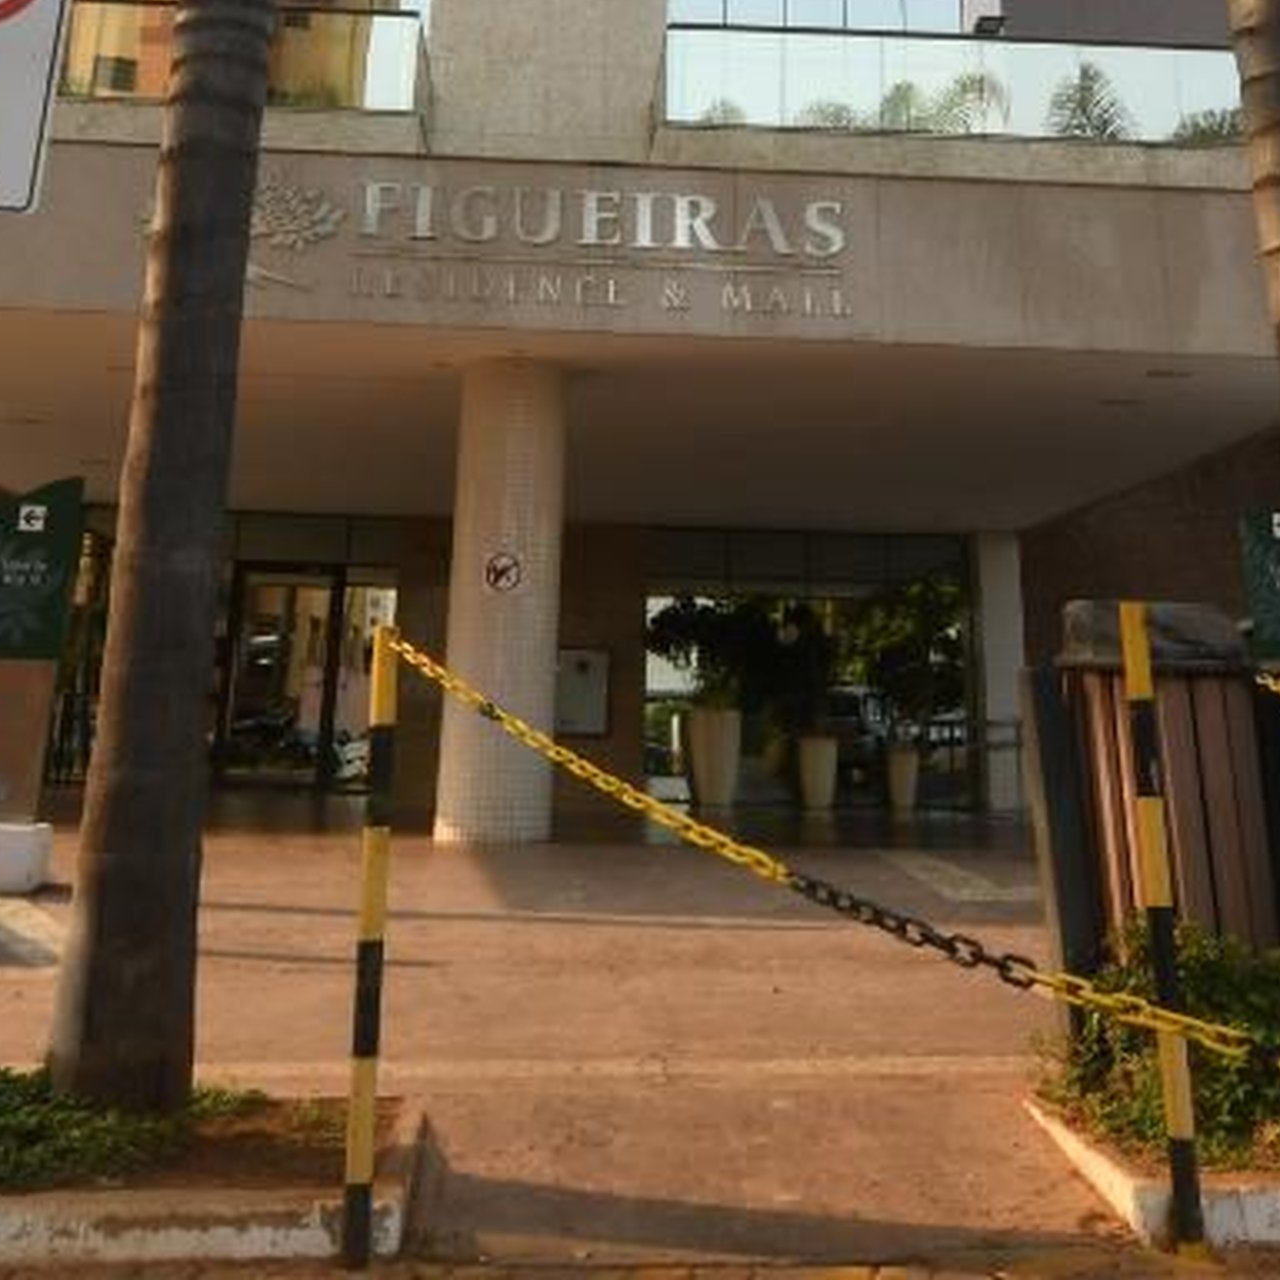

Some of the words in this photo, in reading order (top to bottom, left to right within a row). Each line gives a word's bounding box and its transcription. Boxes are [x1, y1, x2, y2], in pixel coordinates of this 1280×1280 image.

[358, 180, 848, 259] FIGUEIRAS
[349, 265, 627, 306] RESIDENCE
[662, 277, 692, 312] &
[720, 280, 853, 318] MALL
